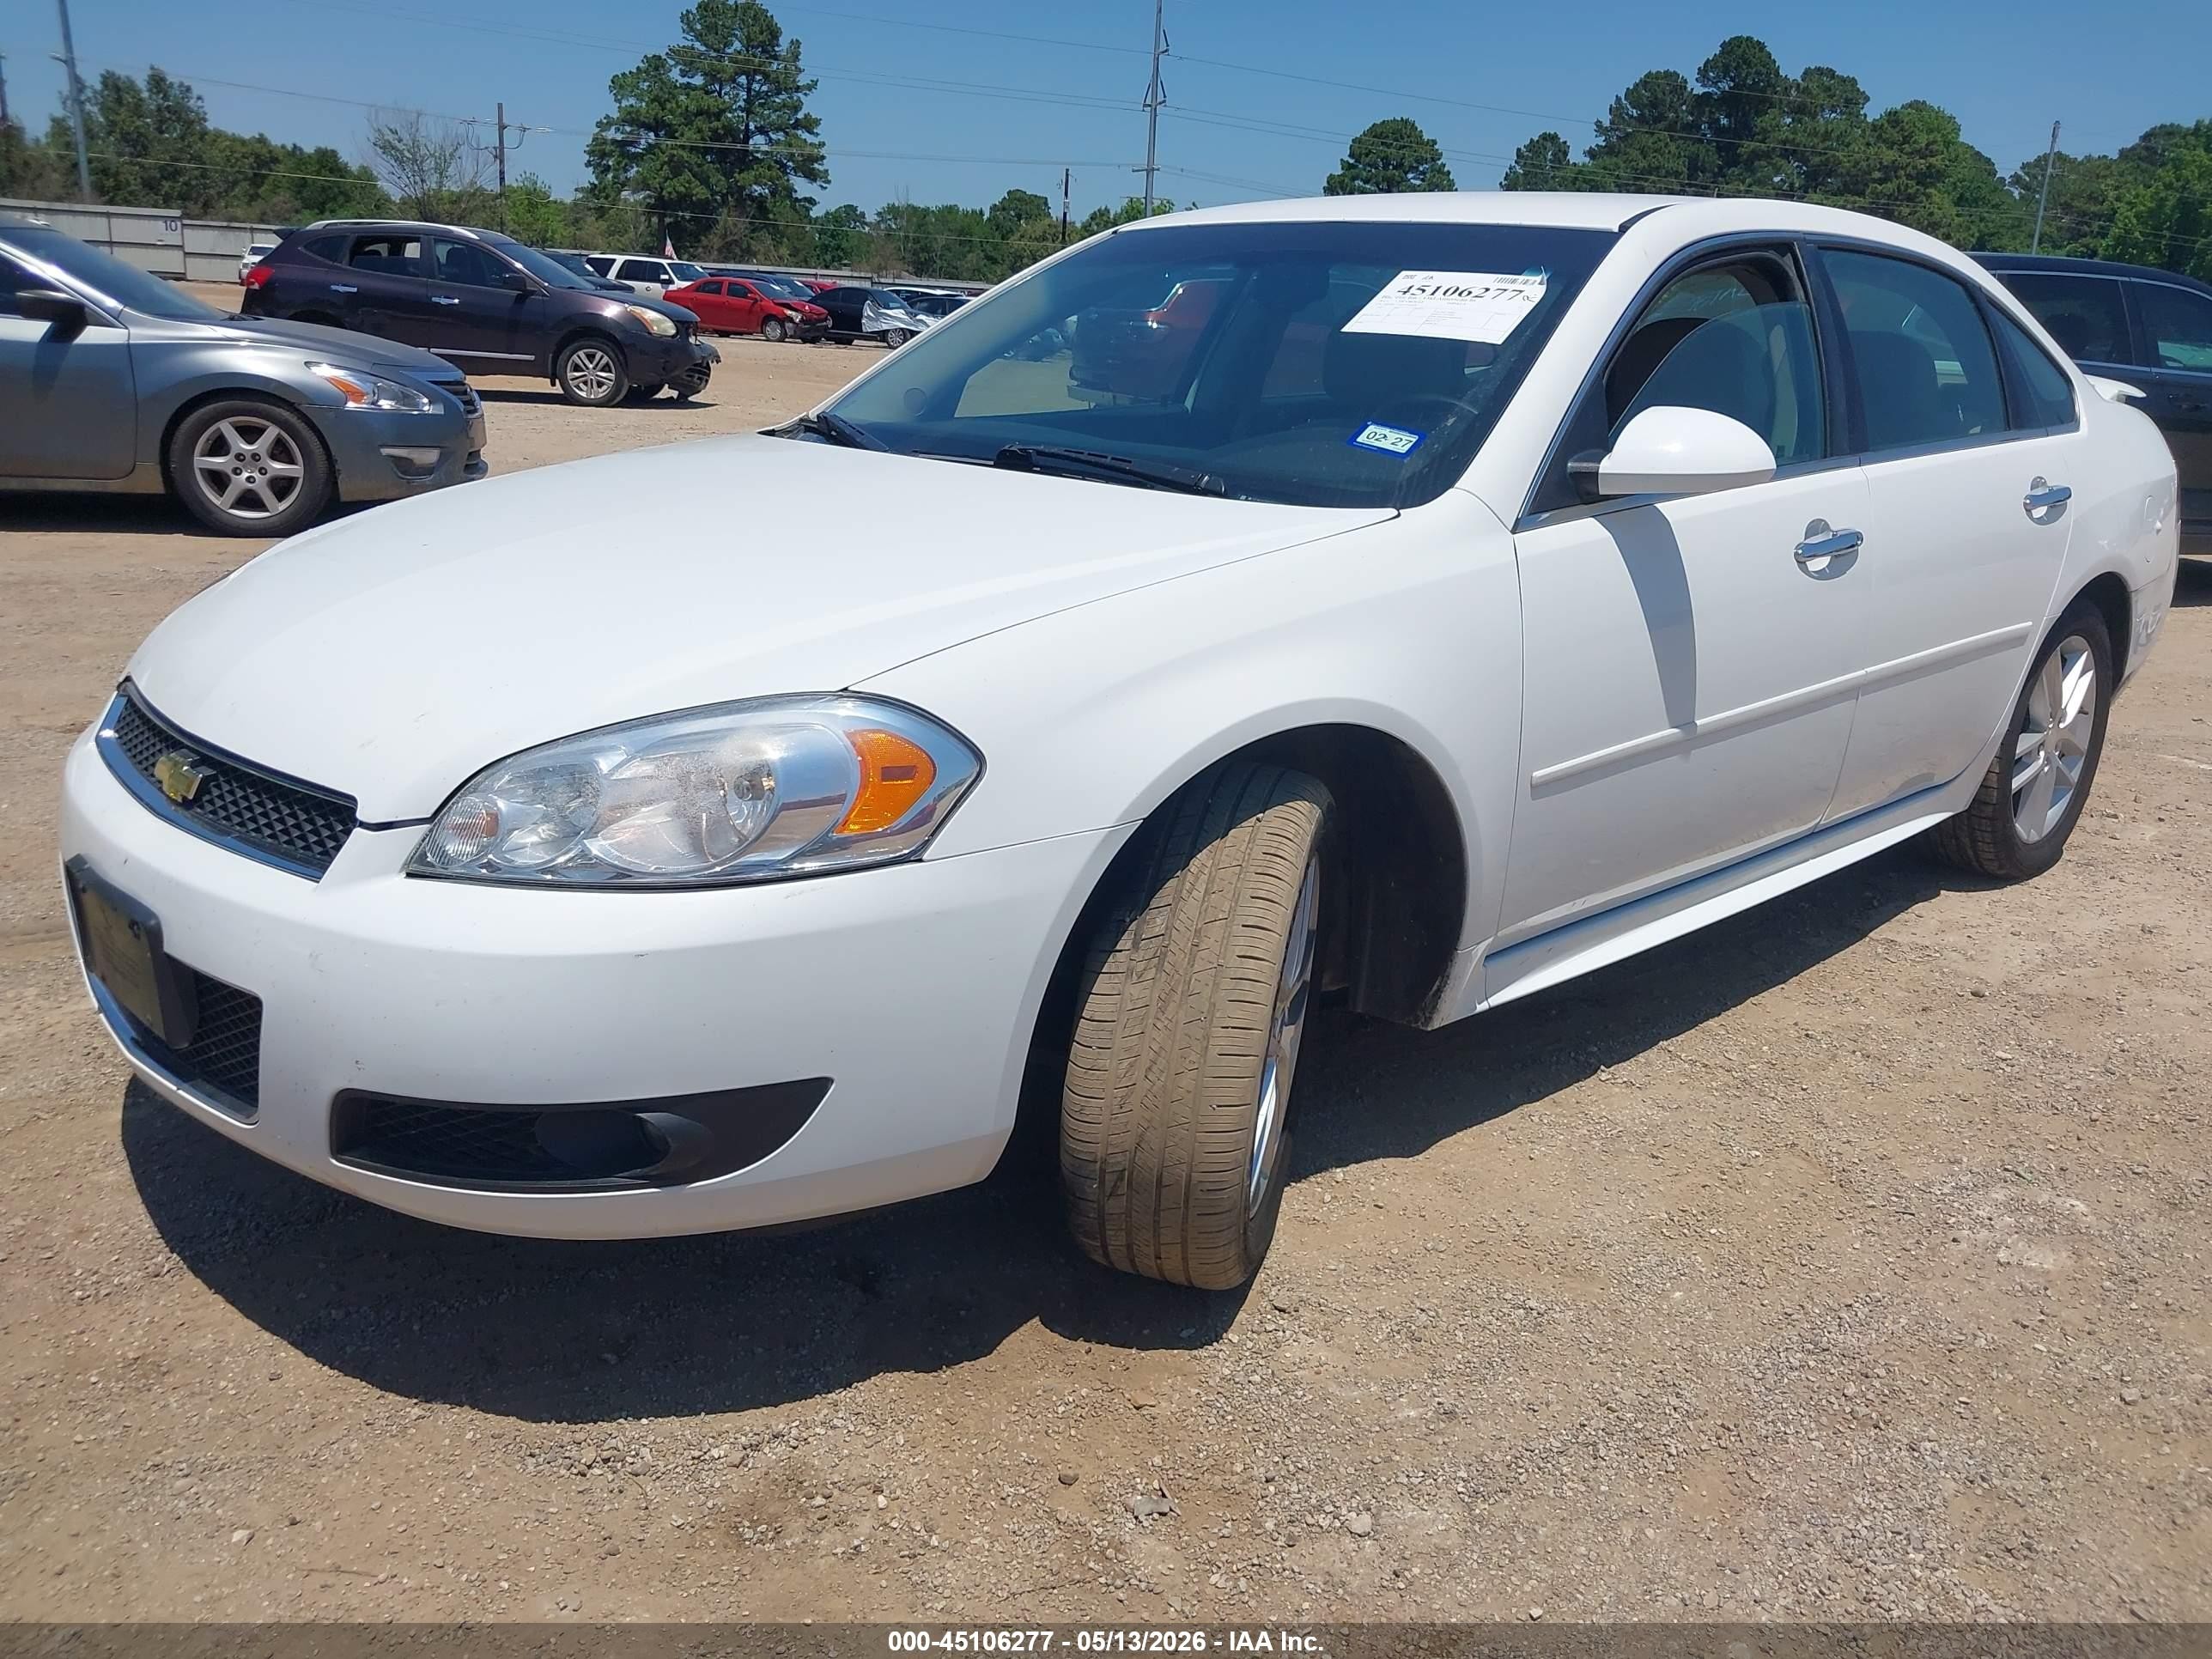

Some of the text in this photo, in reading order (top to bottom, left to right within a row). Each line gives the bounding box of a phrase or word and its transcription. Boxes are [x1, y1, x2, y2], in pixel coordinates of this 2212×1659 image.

[163, 220, 178, 232] 10
[1397, 284, 1525, 301] 45106277
[1390, 436, 1413, 447] 27
